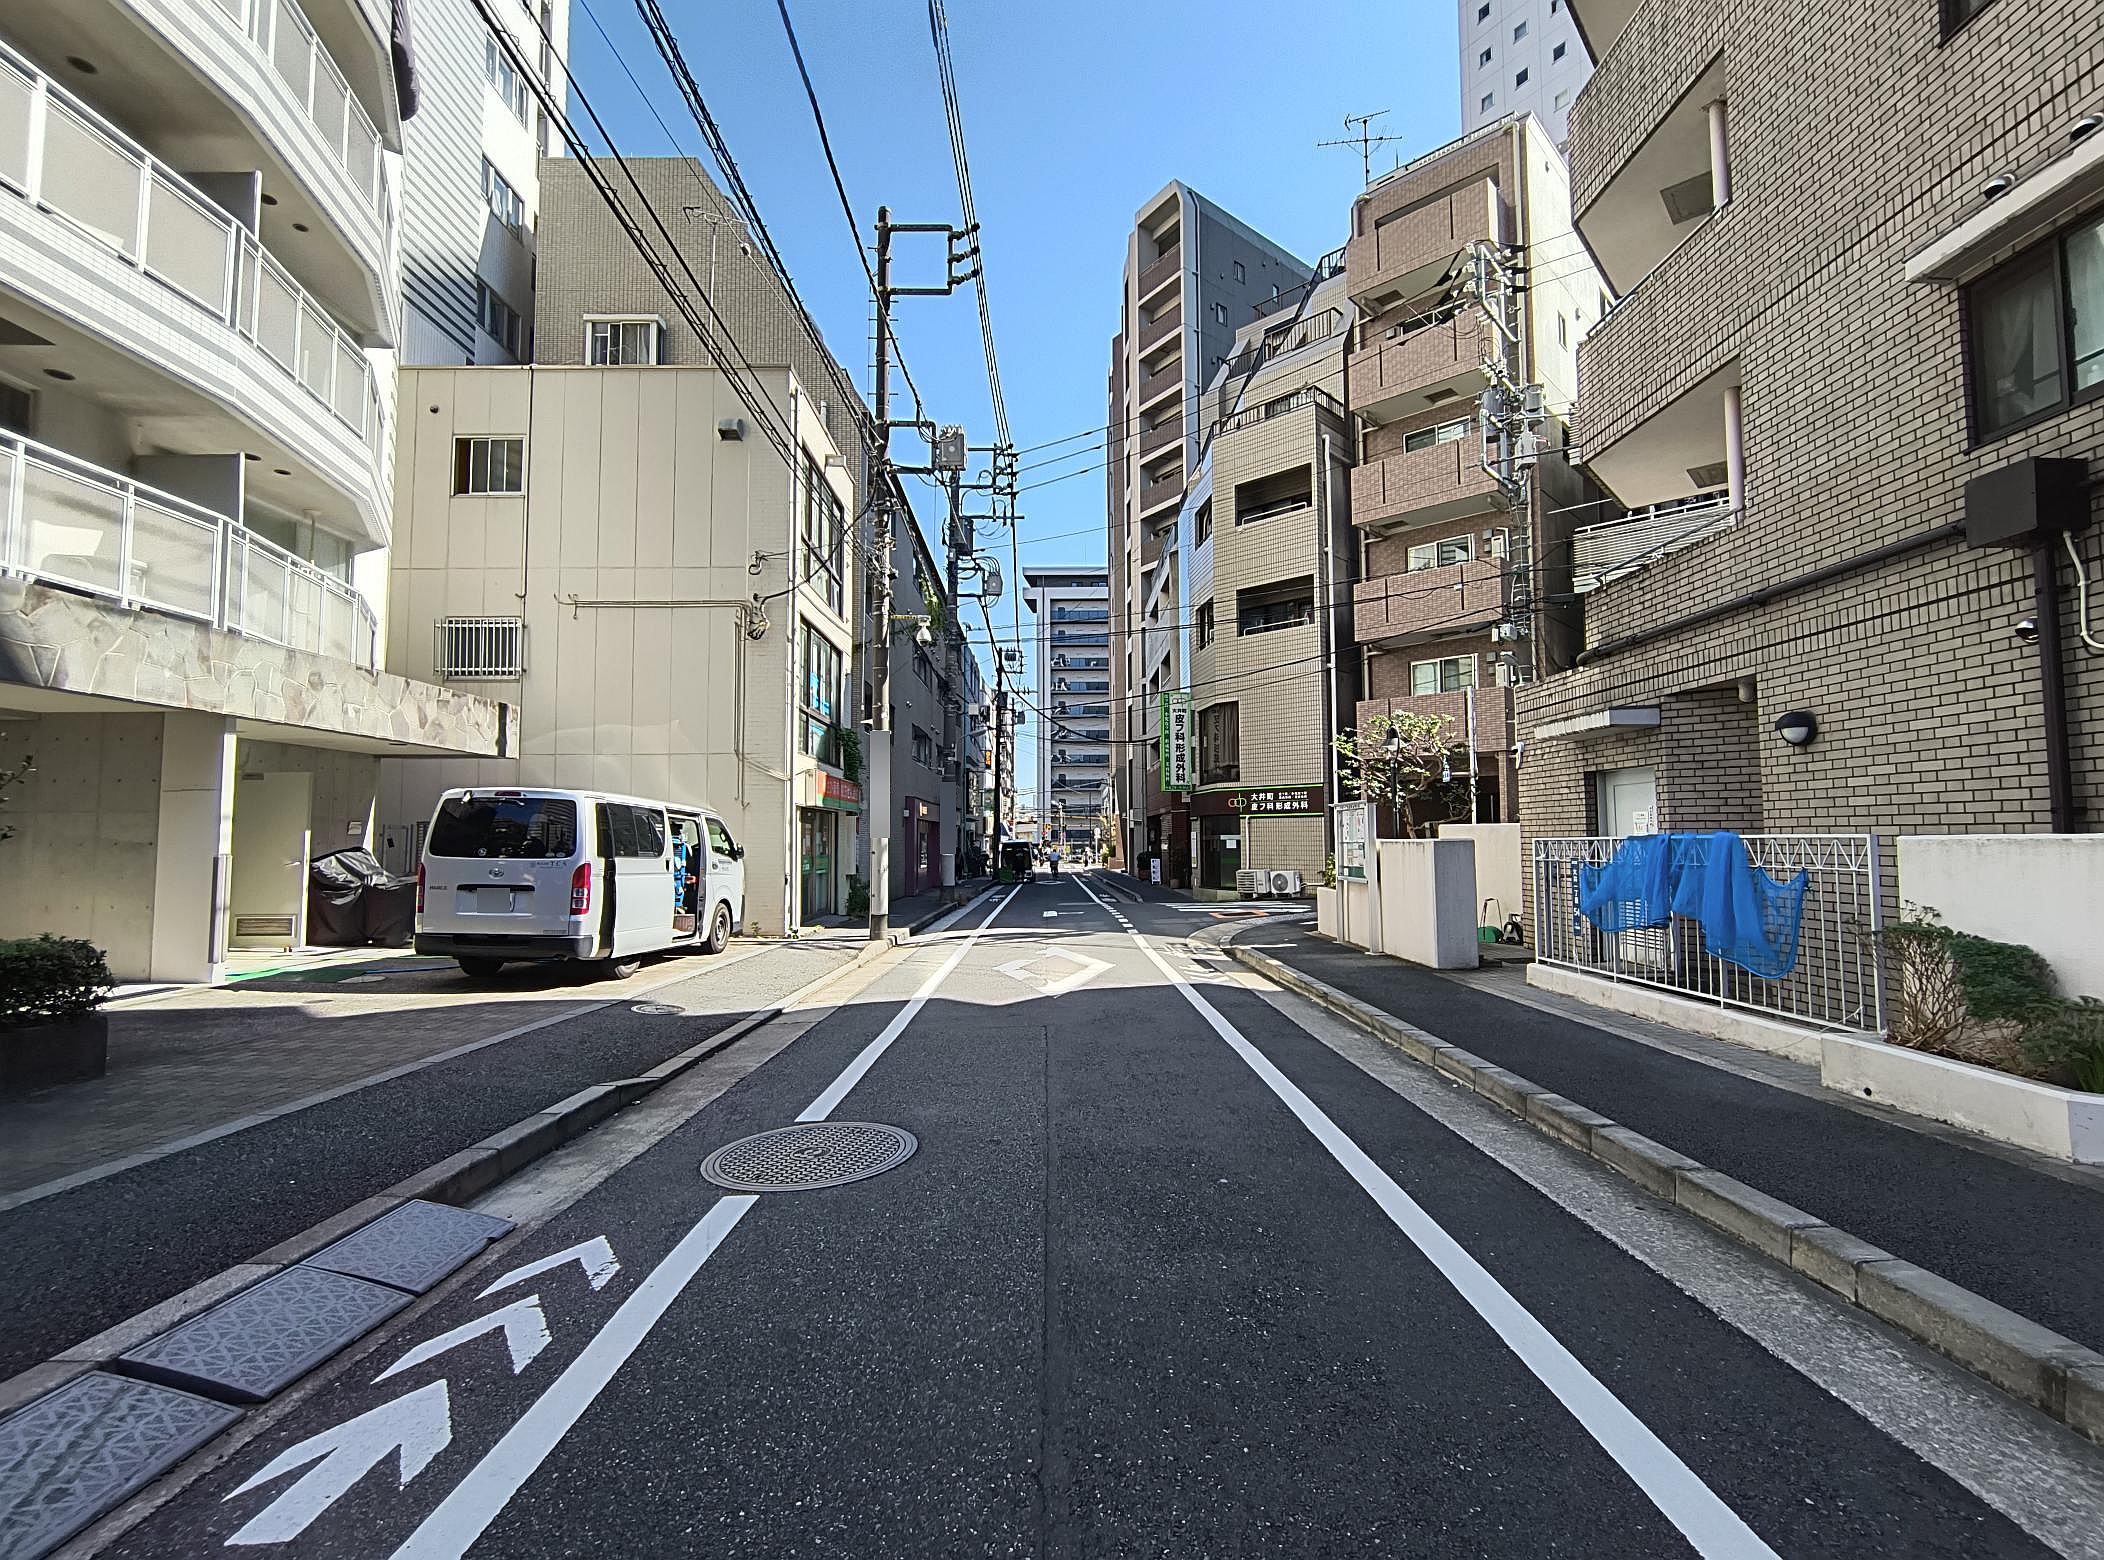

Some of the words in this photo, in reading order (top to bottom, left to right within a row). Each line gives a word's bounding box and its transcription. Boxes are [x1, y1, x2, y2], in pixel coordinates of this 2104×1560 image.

[1175, 714, 1186, 783] 皮フ科形成外科
[1250, 792, 1274, 801] 大井町
